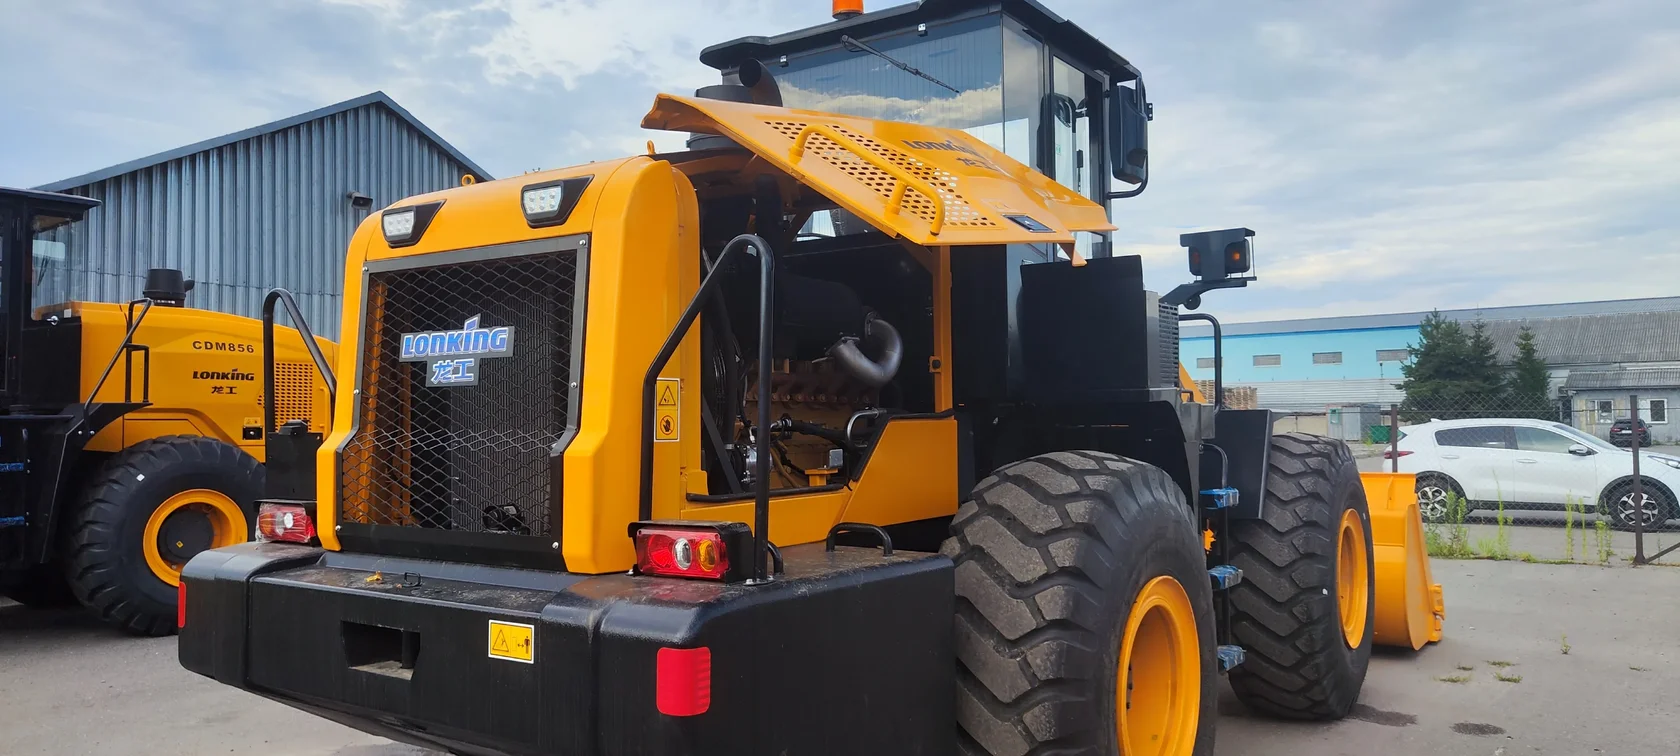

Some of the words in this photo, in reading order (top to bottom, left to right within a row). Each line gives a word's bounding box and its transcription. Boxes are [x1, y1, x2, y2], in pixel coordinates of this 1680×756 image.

[901, 140, 986, 160] LONKI
[192, 340, 254, 354] CDM856
[431, 358, 475, 384] 龙工
[211, 385, 238, 395] 龙工
